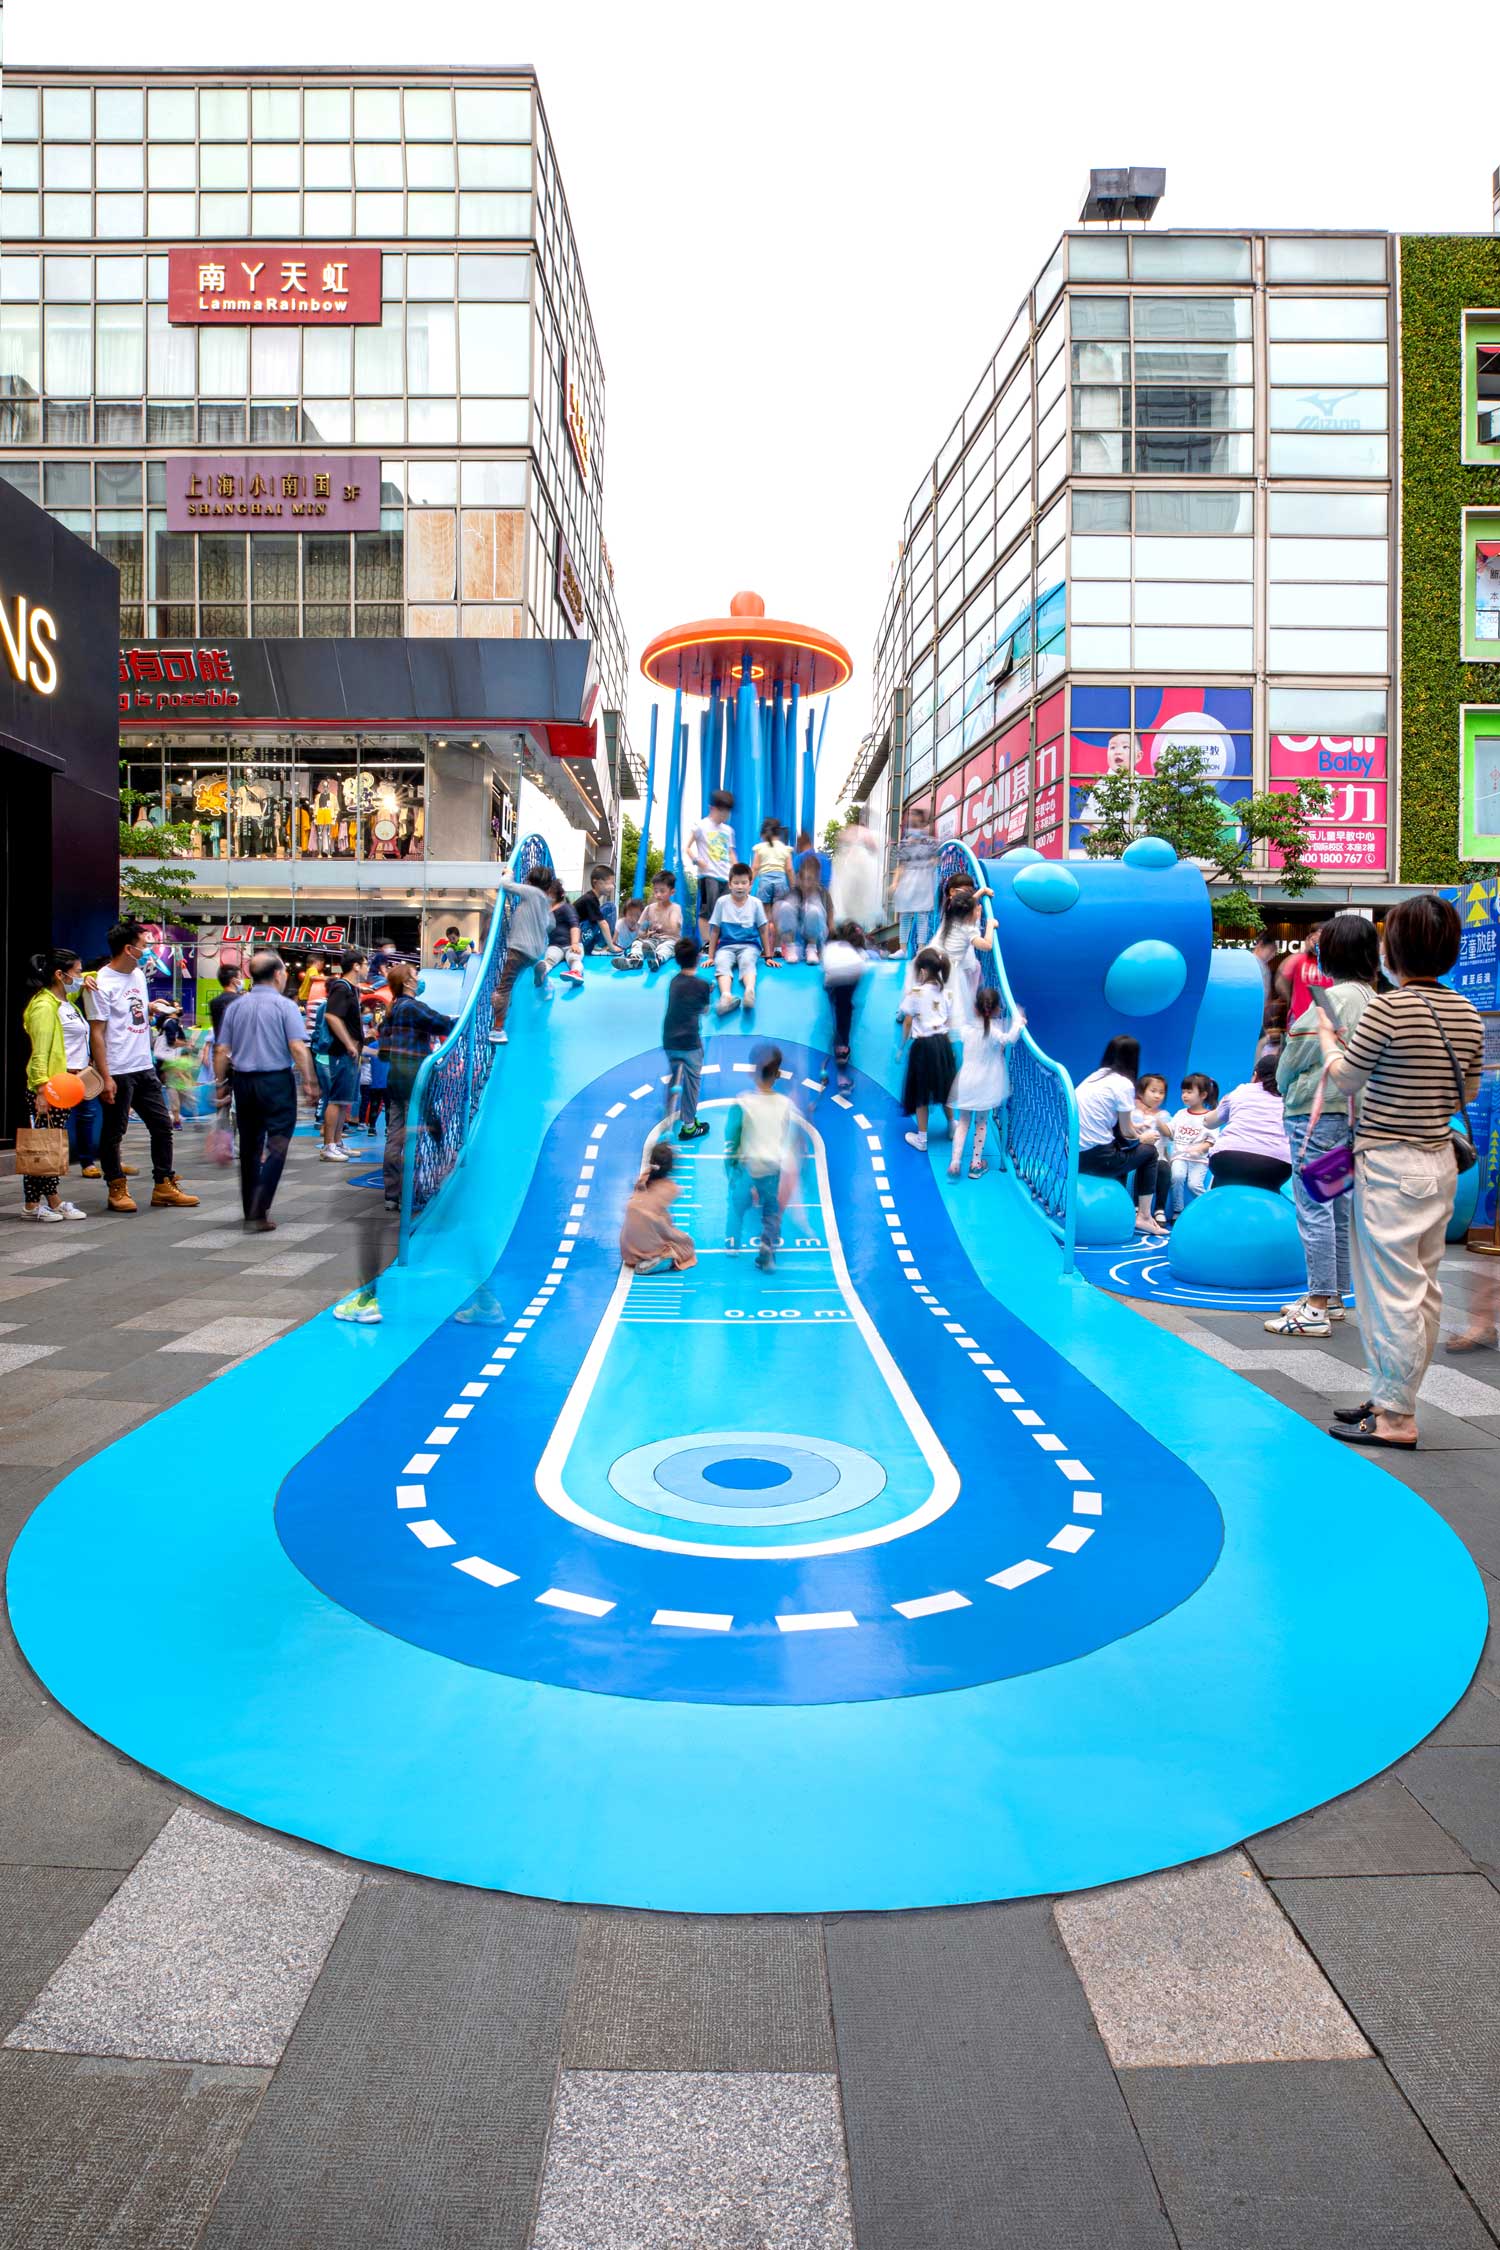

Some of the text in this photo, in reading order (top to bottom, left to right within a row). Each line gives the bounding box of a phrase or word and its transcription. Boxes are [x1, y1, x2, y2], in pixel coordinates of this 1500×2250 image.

[198, 262, 349, 293] 南丫天虹
[342, 485, 361, 501] 3F
[188, 503, 327, 517] SHANGHAI MIN
[134, 689, 153, 706] is
[156, 688, 240, 711] possible
[1318, 751, 1375, 778] Baby
[1319, 853, 1342, 863] 1800
[1344, 853, 1363, 863] 767
[222, 926, 346, 943] LI-NING
[795, 1237, 821, 1247] m
[724, 1309, 848, 1319] 0.00 m
